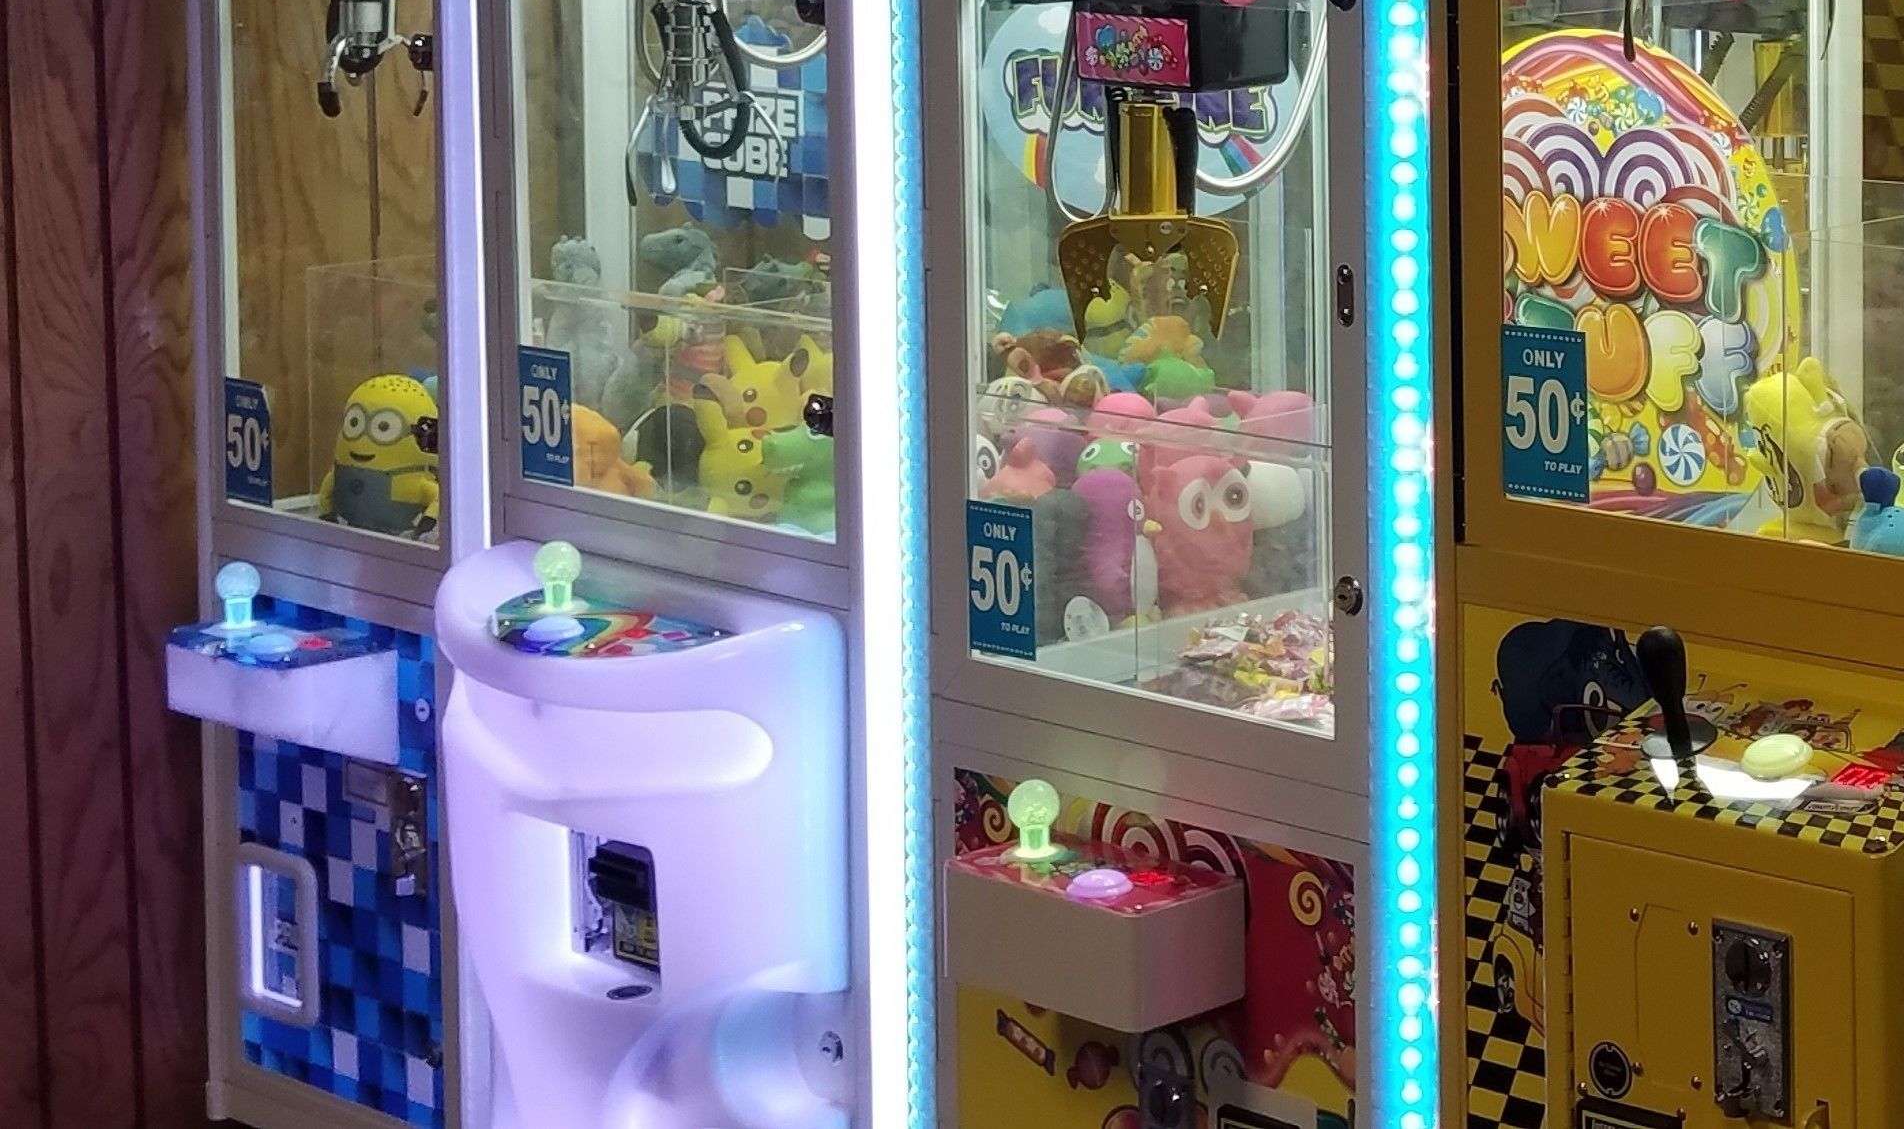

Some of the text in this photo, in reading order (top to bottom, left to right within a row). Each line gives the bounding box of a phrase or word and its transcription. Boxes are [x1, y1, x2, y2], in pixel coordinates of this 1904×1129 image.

[1503, 191, 1764, 323] WEET
[1522, 348, 1565, 369] ONLY
[1544, 460, 1583, 475] TO PLAY
[983, 521, 1018, 542] ONLY
